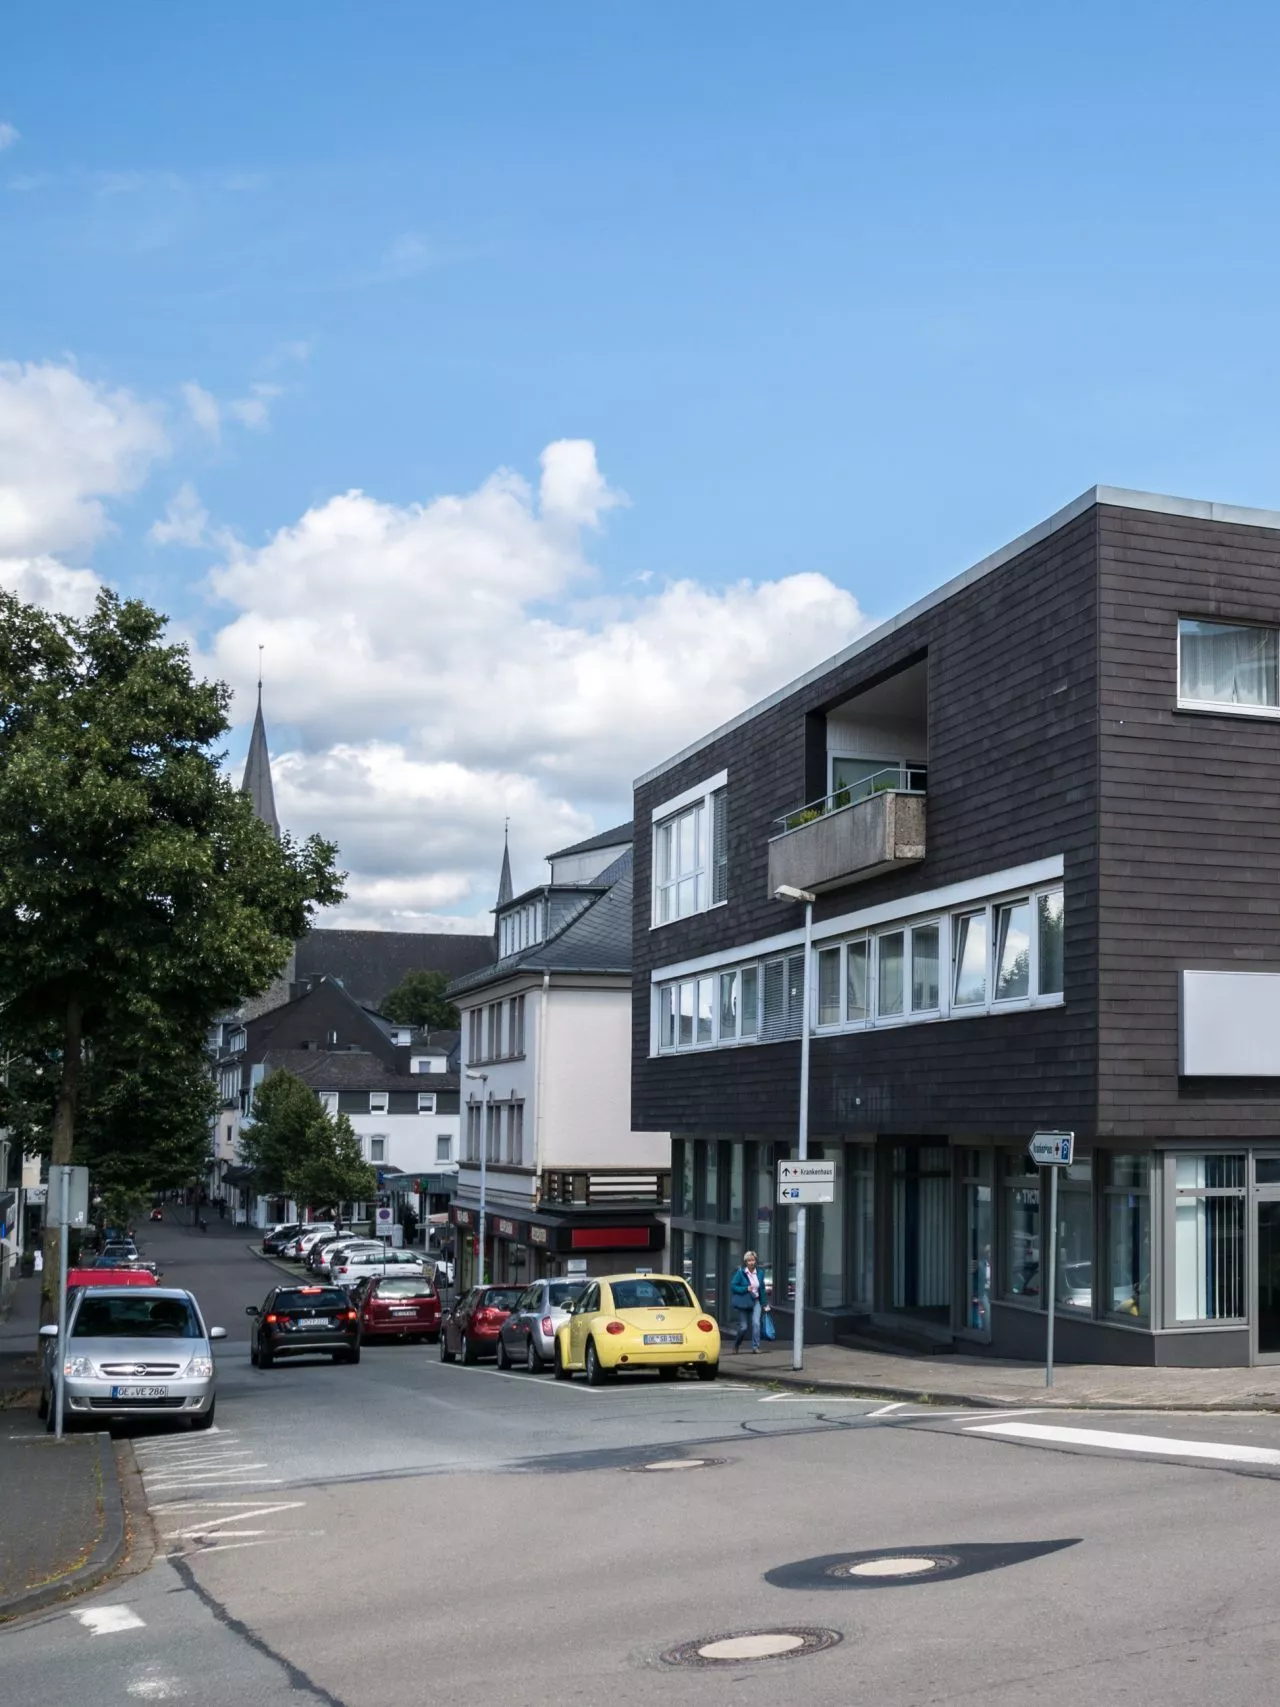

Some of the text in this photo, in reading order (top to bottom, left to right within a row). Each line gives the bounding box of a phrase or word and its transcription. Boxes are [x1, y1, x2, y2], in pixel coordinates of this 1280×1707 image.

[119, 1387, 165, 1396] OE VE 286
